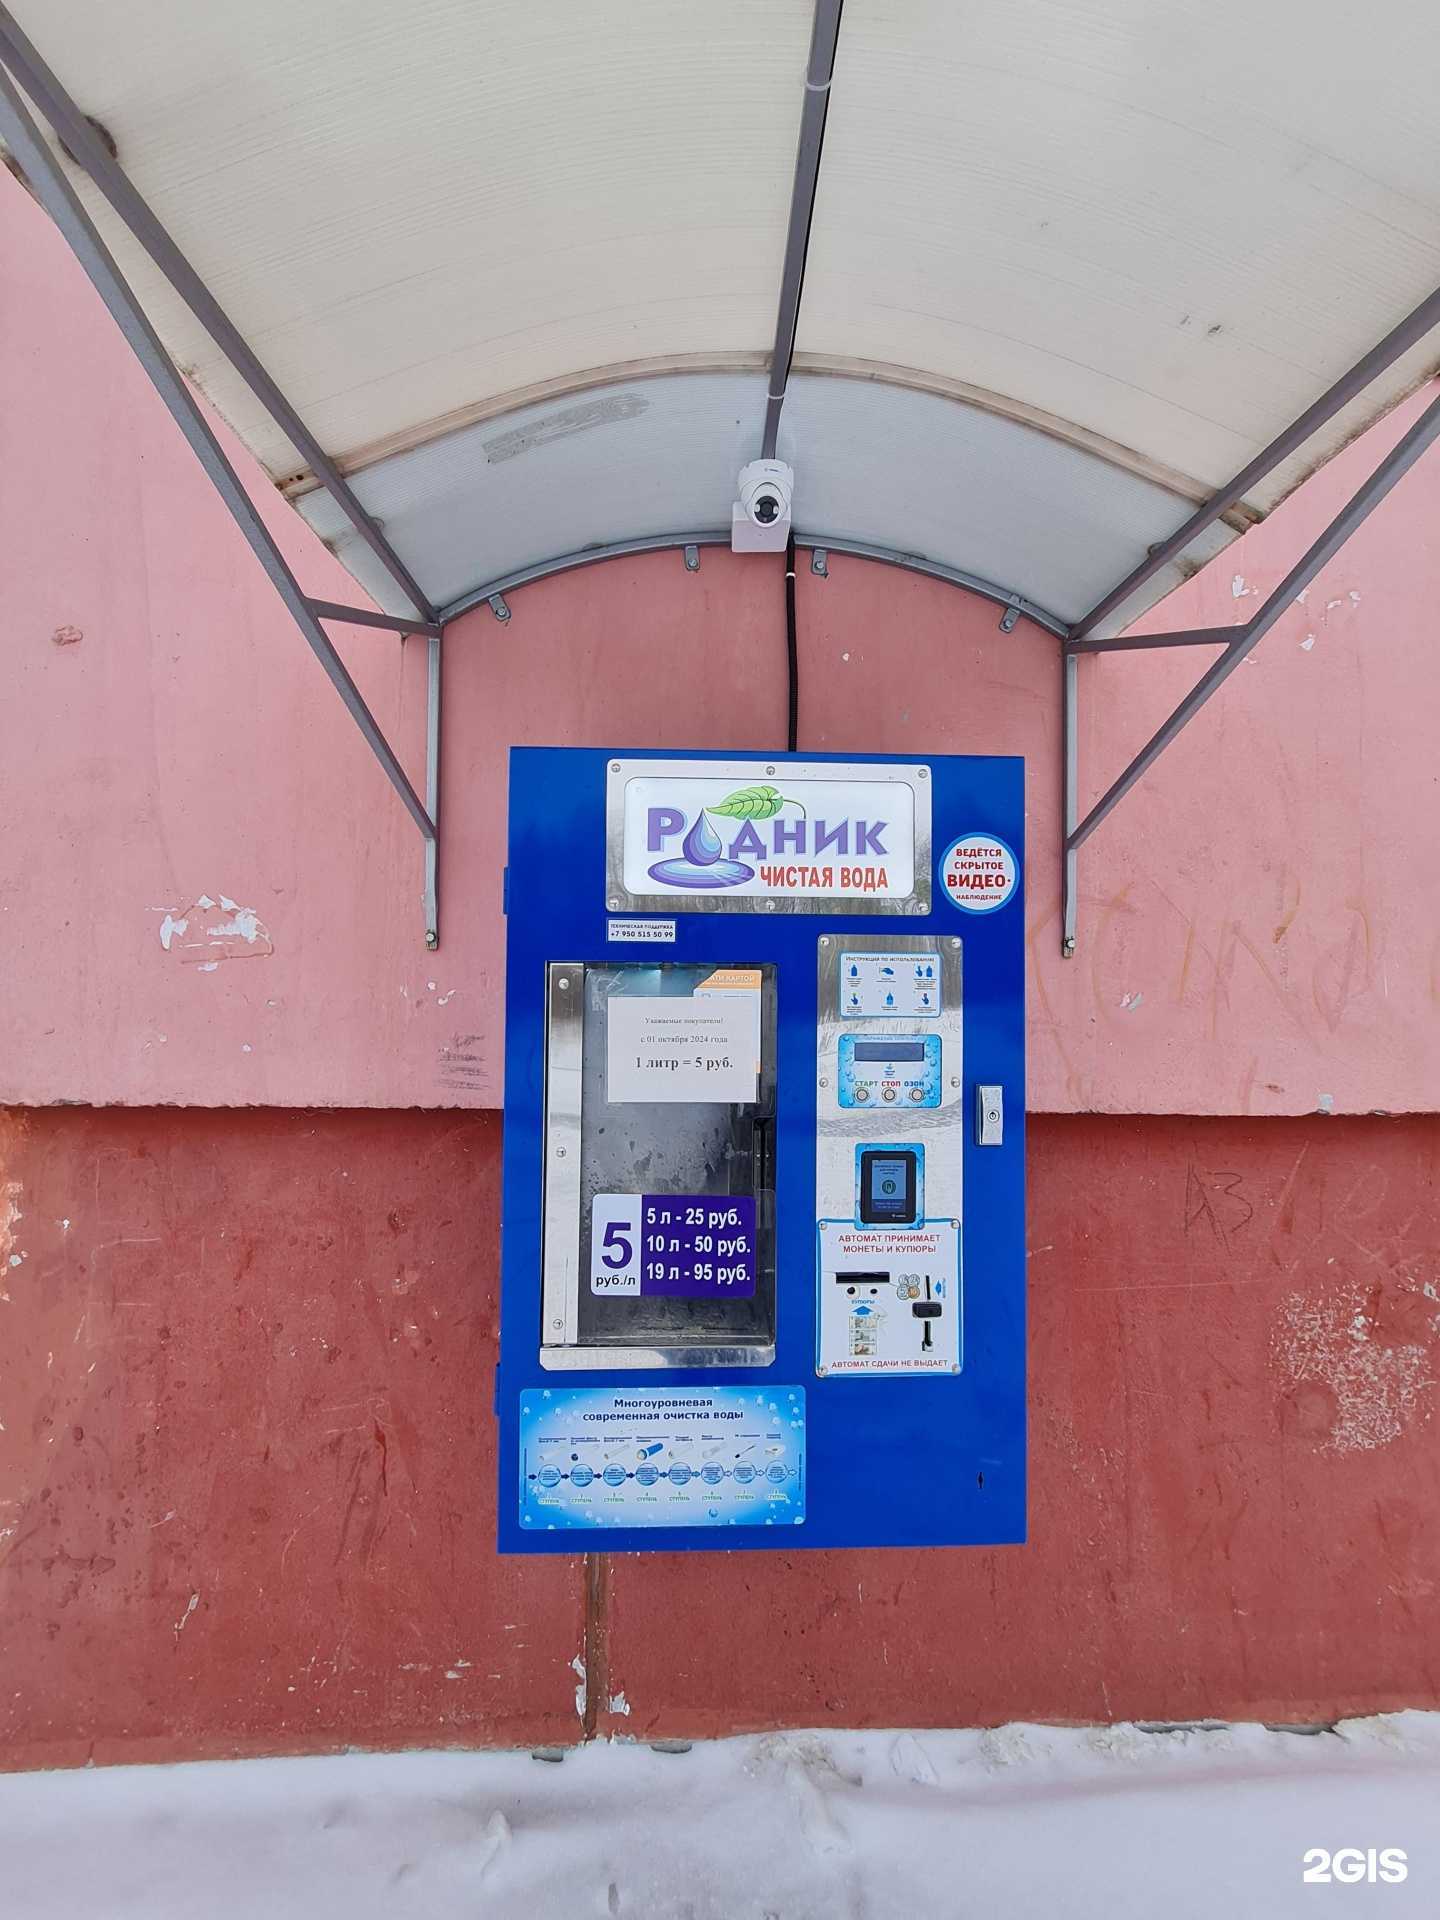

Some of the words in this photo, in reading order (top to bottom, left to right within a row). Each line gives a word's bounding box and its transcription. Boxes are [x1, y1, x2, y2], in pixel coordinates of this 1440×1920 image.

[956, 847, 1002, 857] ВЕДЁТСЯ
[954, 861, 1004, 870] СКРЫТОЕ
[760, 866, 833, 889] ЧИСТАЯ
[840, 867, 888, 892] ВОДА
[683, 1016, 723, 1026] покупатели!
[646, 1035, 655, 1043] 01
[658, 1034, 688, 1045] октября
[690, 1035, 708, 1043] 2024
[711, 1036, 728, 1044] года
[636, 1057, 641, 1068] 1
[645, 1059, 679, 1070] литр
[695, 1056, 702, 1068] 5
[706, 1056, 733, 1071] руб.
[647, 1207, 656, 1224] 5
[660, 1211, 671, 1224] л
[685, 1208, 704, 1225] 25
[708, 1208, 742, 1229] руб.
[838, 1234, 882, 1243] АВТОМАТ
[884, 1234, 941, 1242] ПРИНИМАЕТ
[601, 1222, 633, 1269] 5
[647, 1235, 665, 1252] 10
[669, 1239, 680, 1252] л
[694, 1236, 713, 1253] 50
[717, 1236, 751, 1257] руб.
[843, 1245, 884, 1253] МОНЕТЫ
[895, 1245, 936, 1253] КУПЮРЫ
[647, 1263, 664, 1280] 19
[668, 1267, 679, 1280] л
[694, 1263, 712, 1281] 95
[717, 1264, 751, 1285] руб.
[596, 1274, 636, 1288] руб./л
[831, 1360, 869, 1369] АВТОМАТ
[871, 1360, 899, 1368] СДАЧИ
[901, 1359, 912, 1367] НЕ
[914, 1359, 948, 1368] ВЫДАЕТ
[614, 1398, 713, 1409] Многоуровневая
[583, 1412, 660, 1422] современная
[663, 1411, 710, 1420] очистка
[713, 1410, 744, 1420] воды
